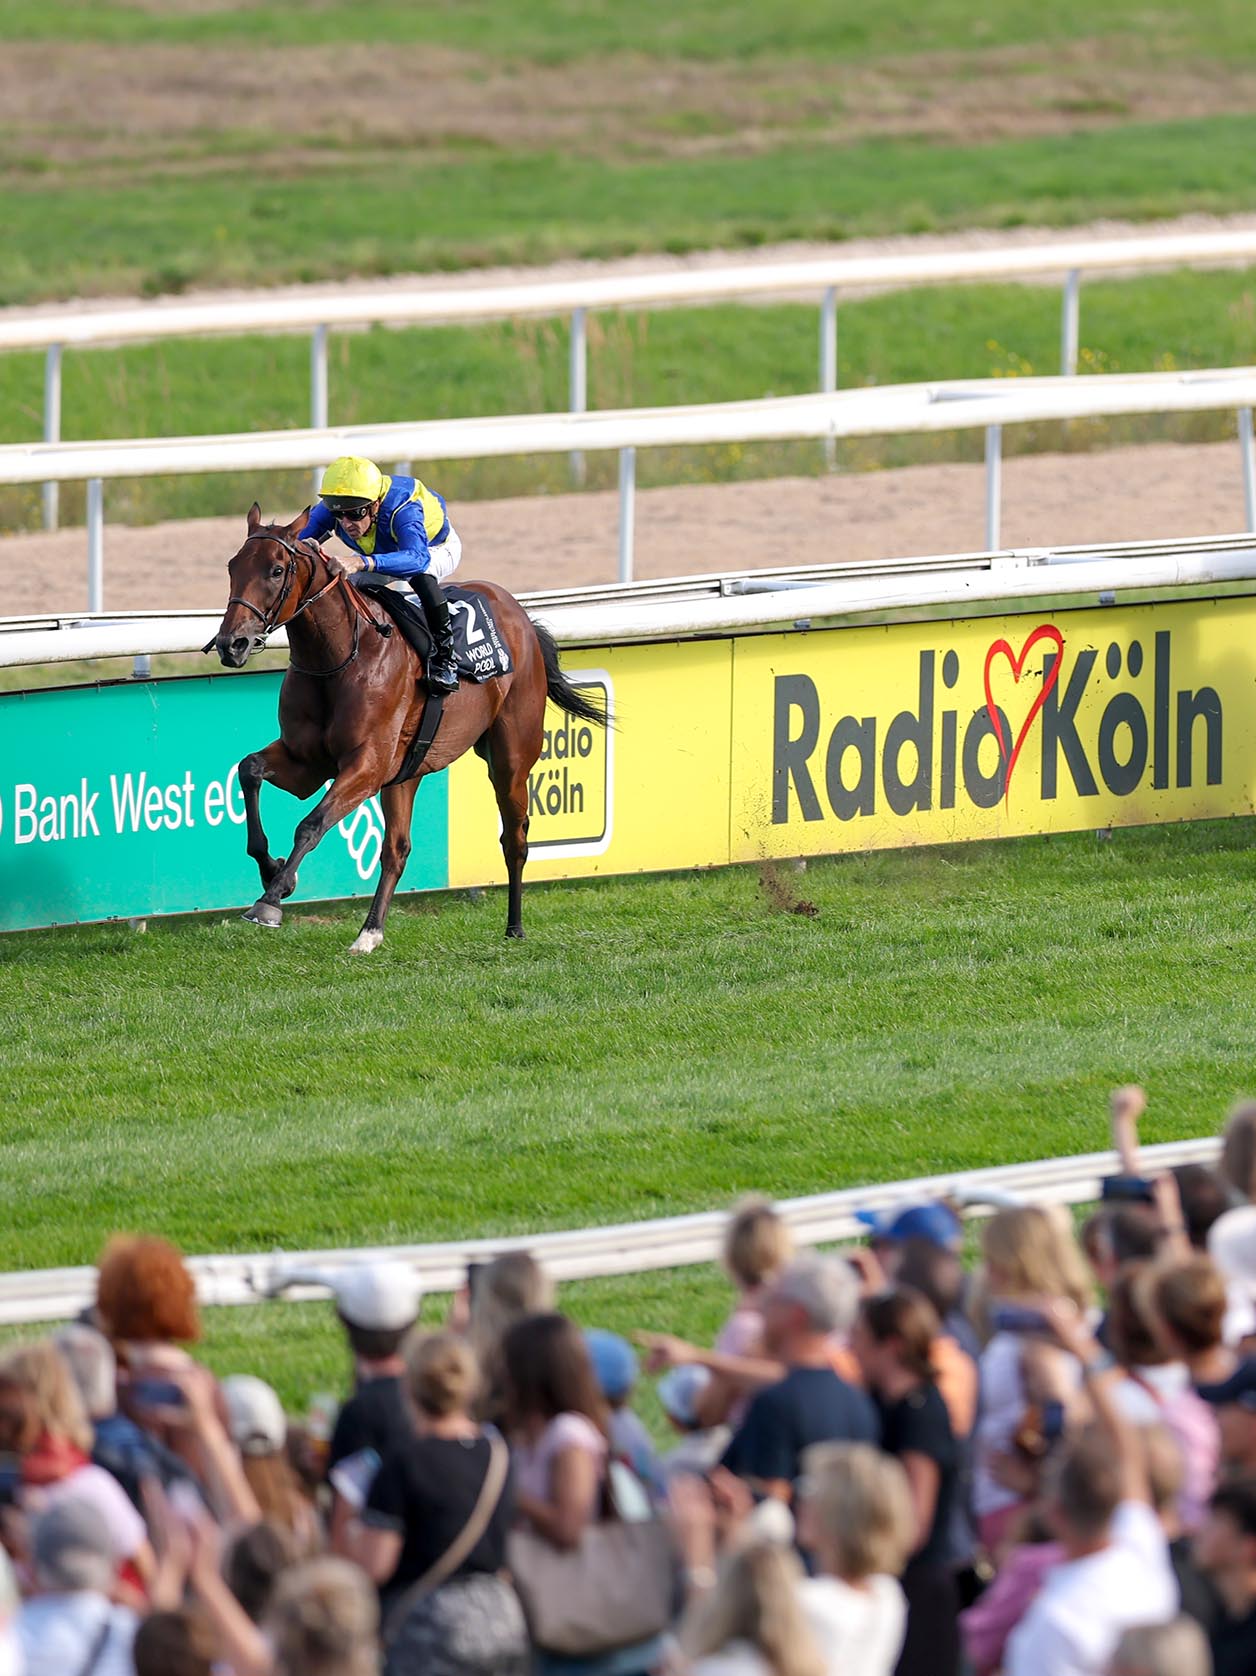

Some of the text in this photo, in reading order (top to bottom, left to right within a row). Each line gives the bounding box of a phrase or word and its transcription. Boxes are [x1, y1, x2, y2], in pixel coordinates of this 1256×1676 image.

[447, 600, 485, 646] 2
[465, 642, 494, 662] WORLD
[473, 657, 496, 675] POOL
[540, 710, 593, 760] adio
[772, 631, 1222, 825] Radio Köln
[14, 761, 247, 845] Bank West eG
[528, 766, 584, 816] Köln
